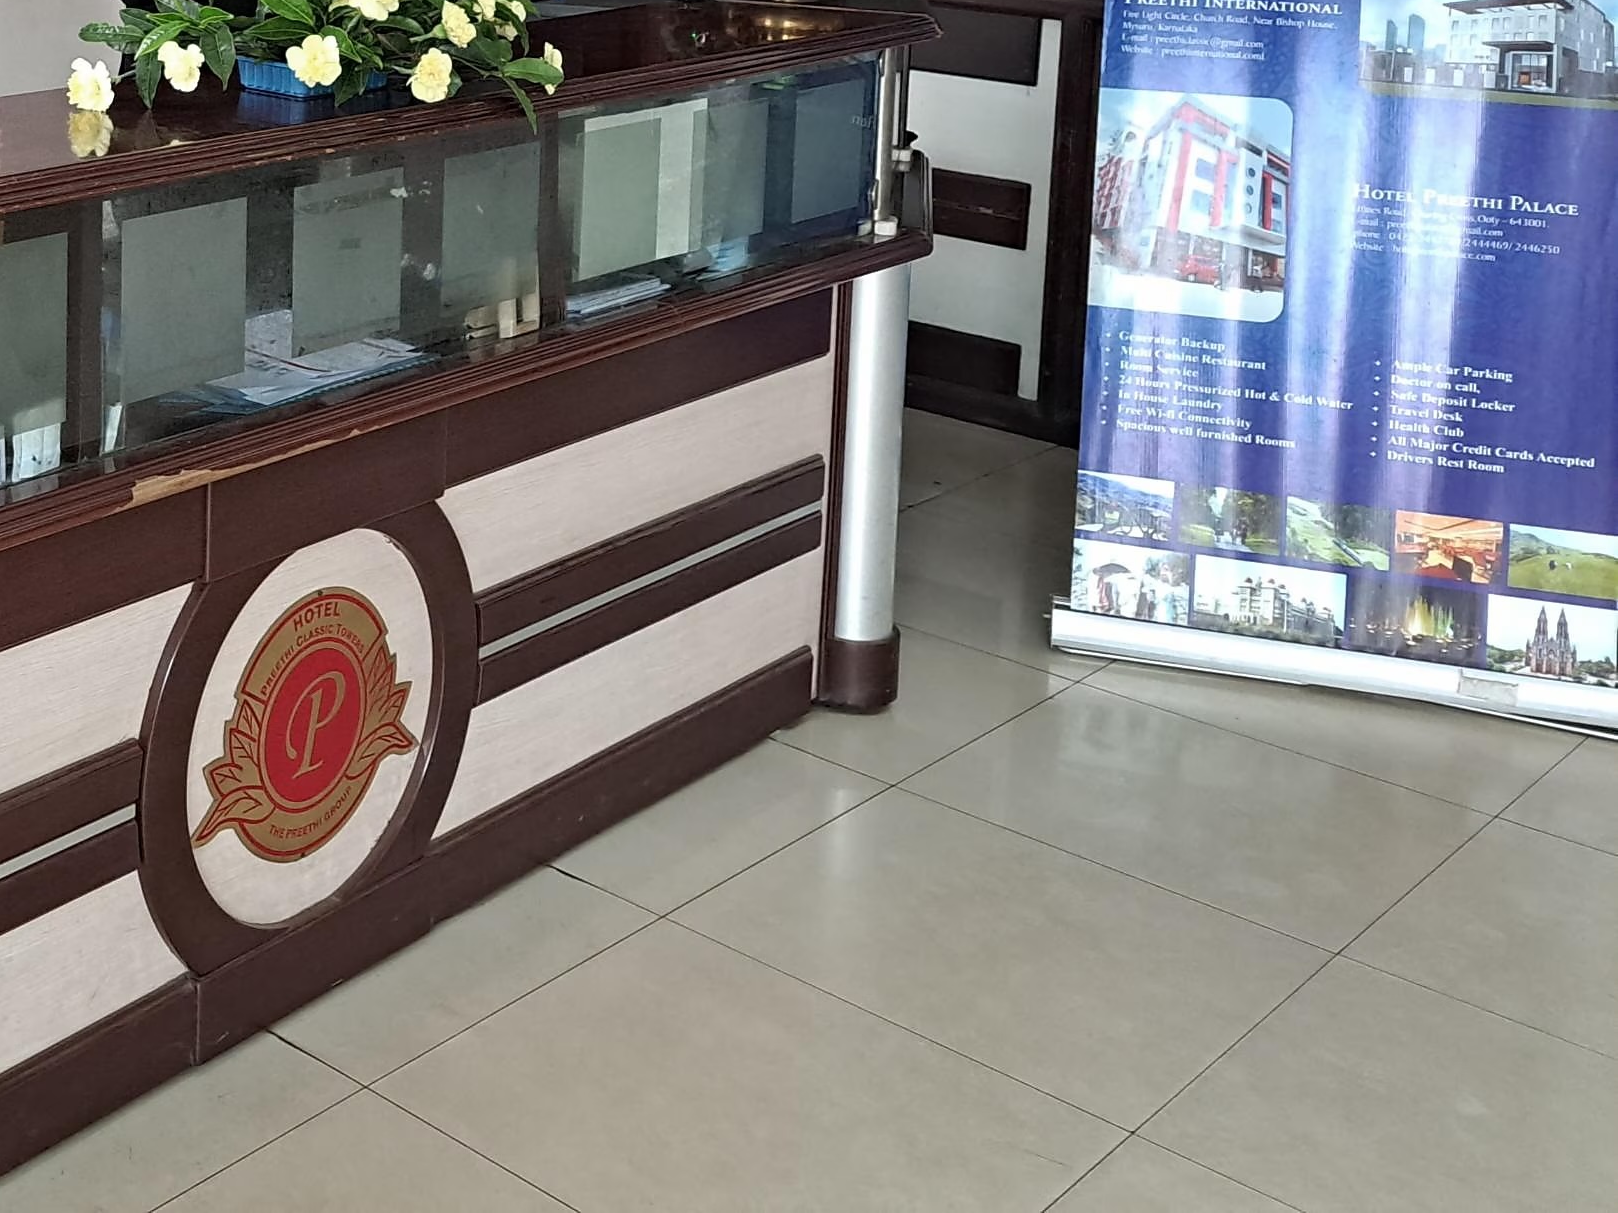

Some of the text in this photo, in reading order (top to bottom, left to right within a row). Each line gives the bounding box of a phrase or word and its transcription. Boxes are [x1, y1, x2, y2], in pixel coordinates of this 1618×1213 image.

[1353, 183, 1415, 203] HOTEL
[1509, 195, 1579, 216] PALACE
[1182, 337, 1226, 353] Backup
[1202, 355, 1266, 371] Restaurant
[1435, 365, 1460, 376] Car
[1463, 367, 1513, 383] Parking
[1391, 374, 1432, 388] Doctor
[1436, 381, 1452, 390] on
[1135, 392, 1168, 404] House
[1173, 395, 1223, 413] Laundry
[1174, 381, 1241, 398] Pressurized
[1245, 390, 1266, 401] Hot
[1269, 392, 1280, 402] &
[1284, 393, 1313, 406] Cold
[1316, 397, 1354, 410] Water
[1391, 389, 1516, 413] Safe Deposit Locker
[1118, 405, 1142, 416] Free
[1179, 411, 1252, 430] Connectivity
[1390, 404, 1463, 423] Travel Desk
[1116, 419, 1296, 449] Spacious well furnished Rooms
[1389, 420, 1464, 438] Health Club
[1387, 450, 1505, 474] Drivers Rest Room
[1388, 435, 1596, 468] All Major Credit Cards Accepted
[293, 601, 340, 633] HOTEL
[260, 644, 295, 697] PREETHI
[296, 624, 334, 647] CLASSIC
[284, 670, 346, 780] P
[269, 785, 352, 839] THE PREETHI GROUP
